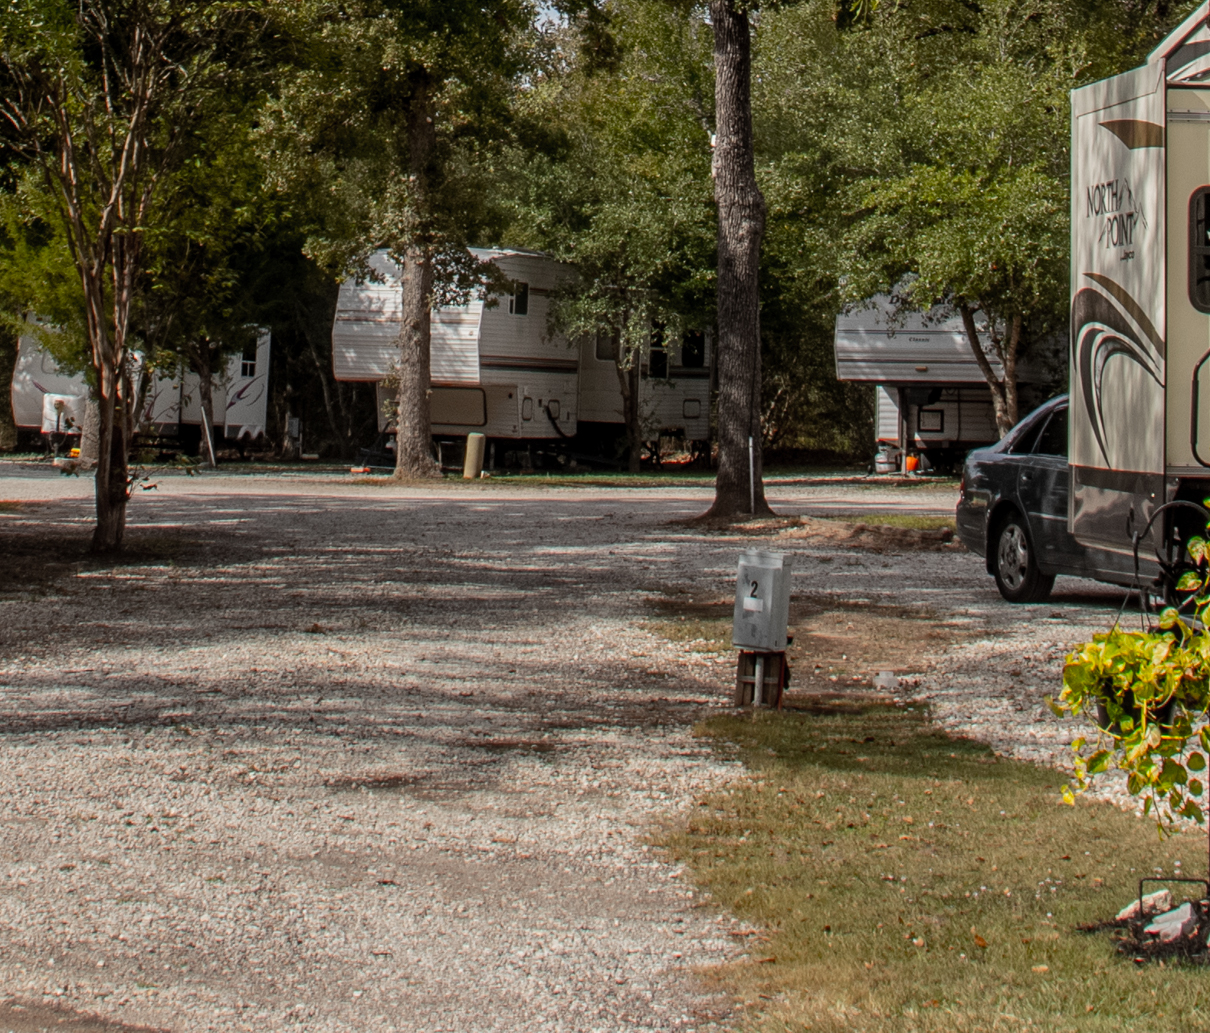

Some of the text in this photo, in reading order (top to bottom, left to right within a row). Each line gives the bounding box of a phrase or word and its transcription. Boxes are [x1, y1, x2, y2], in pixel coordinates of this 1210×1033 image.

[1086, 179, 1119, 218] NORTH
[1106, 211, 1134, 249] POINT
[750, 580, 759, 599] 2
